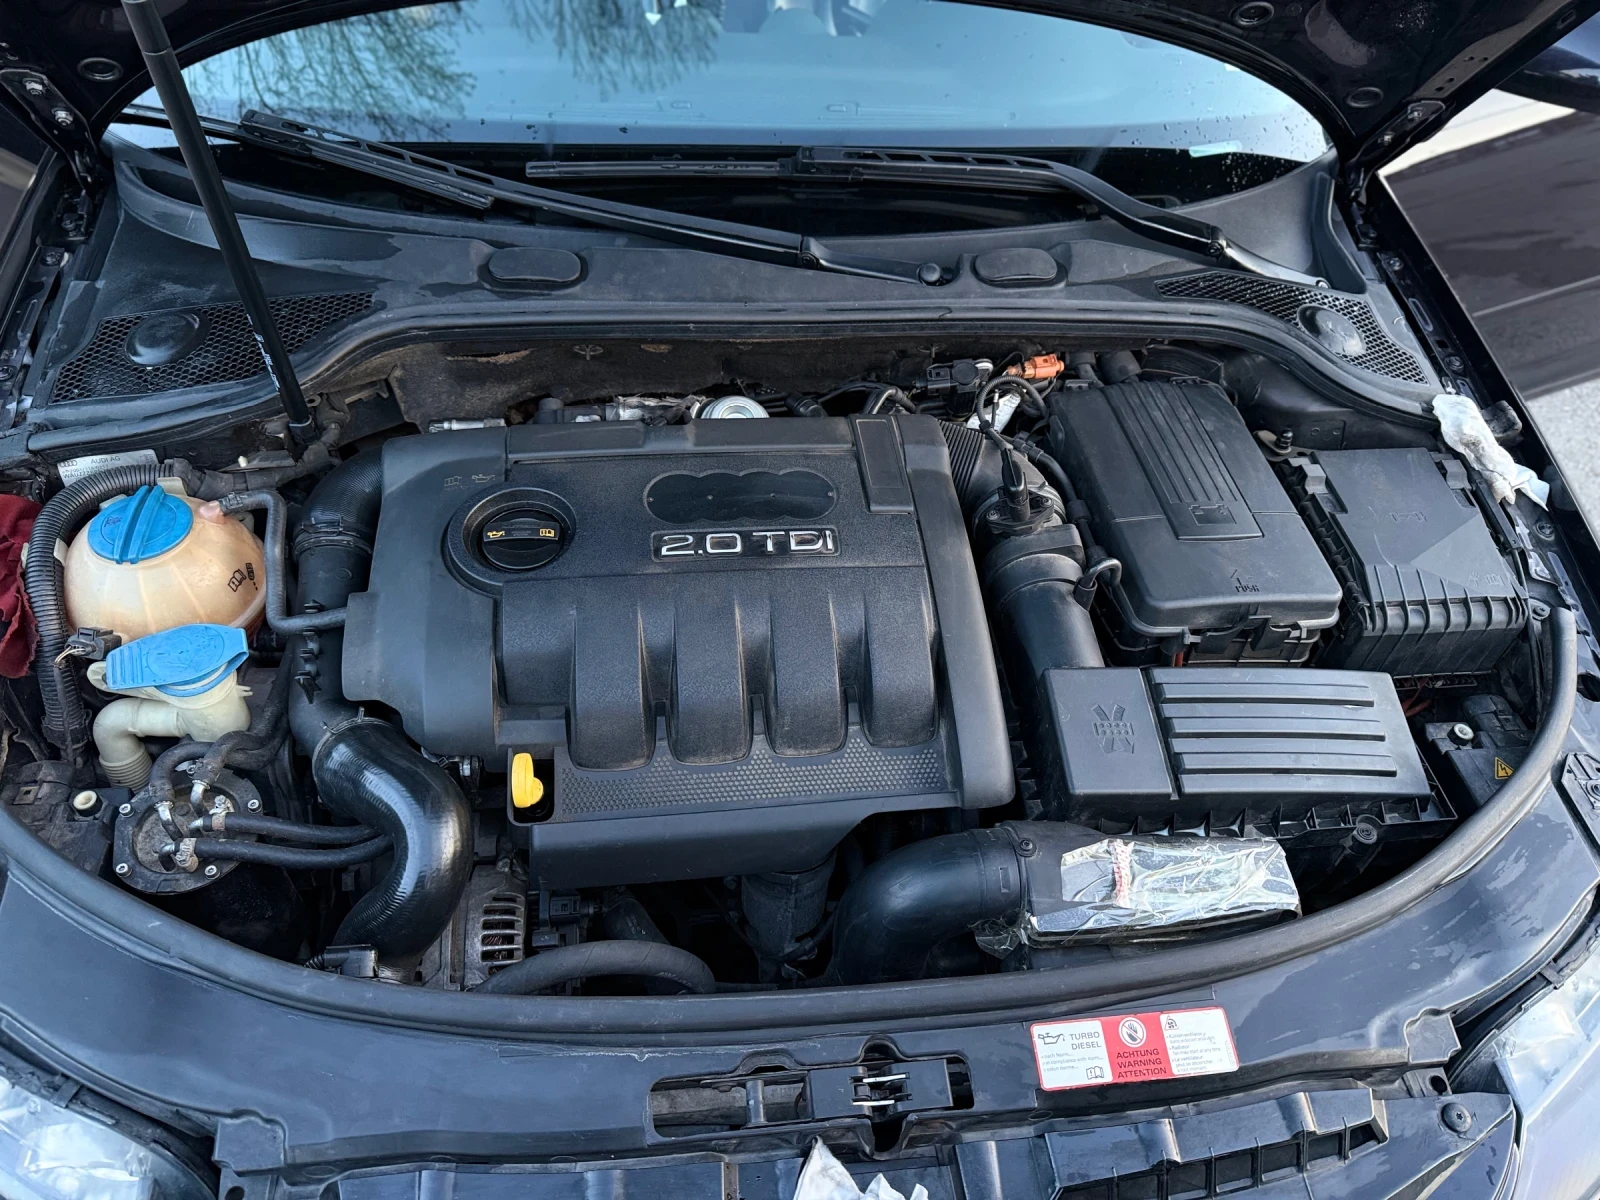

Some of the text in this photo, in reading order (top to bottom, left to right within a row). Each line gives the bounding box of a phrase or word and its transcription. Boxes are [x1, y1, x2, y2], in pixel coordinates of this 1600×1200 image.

[661, 530, 834, 557] 2.0 TDI
[1069, 1031, 1100, 1041] TURBO
[1071, 1041, 1102, 1051] DIESEL
[1116, 1048, 1160, 1059] ACHTUNG
[1117, 1058, 1163, 1069] WARNING
[1118, 1067, 1167, 1079] ATTENTION
